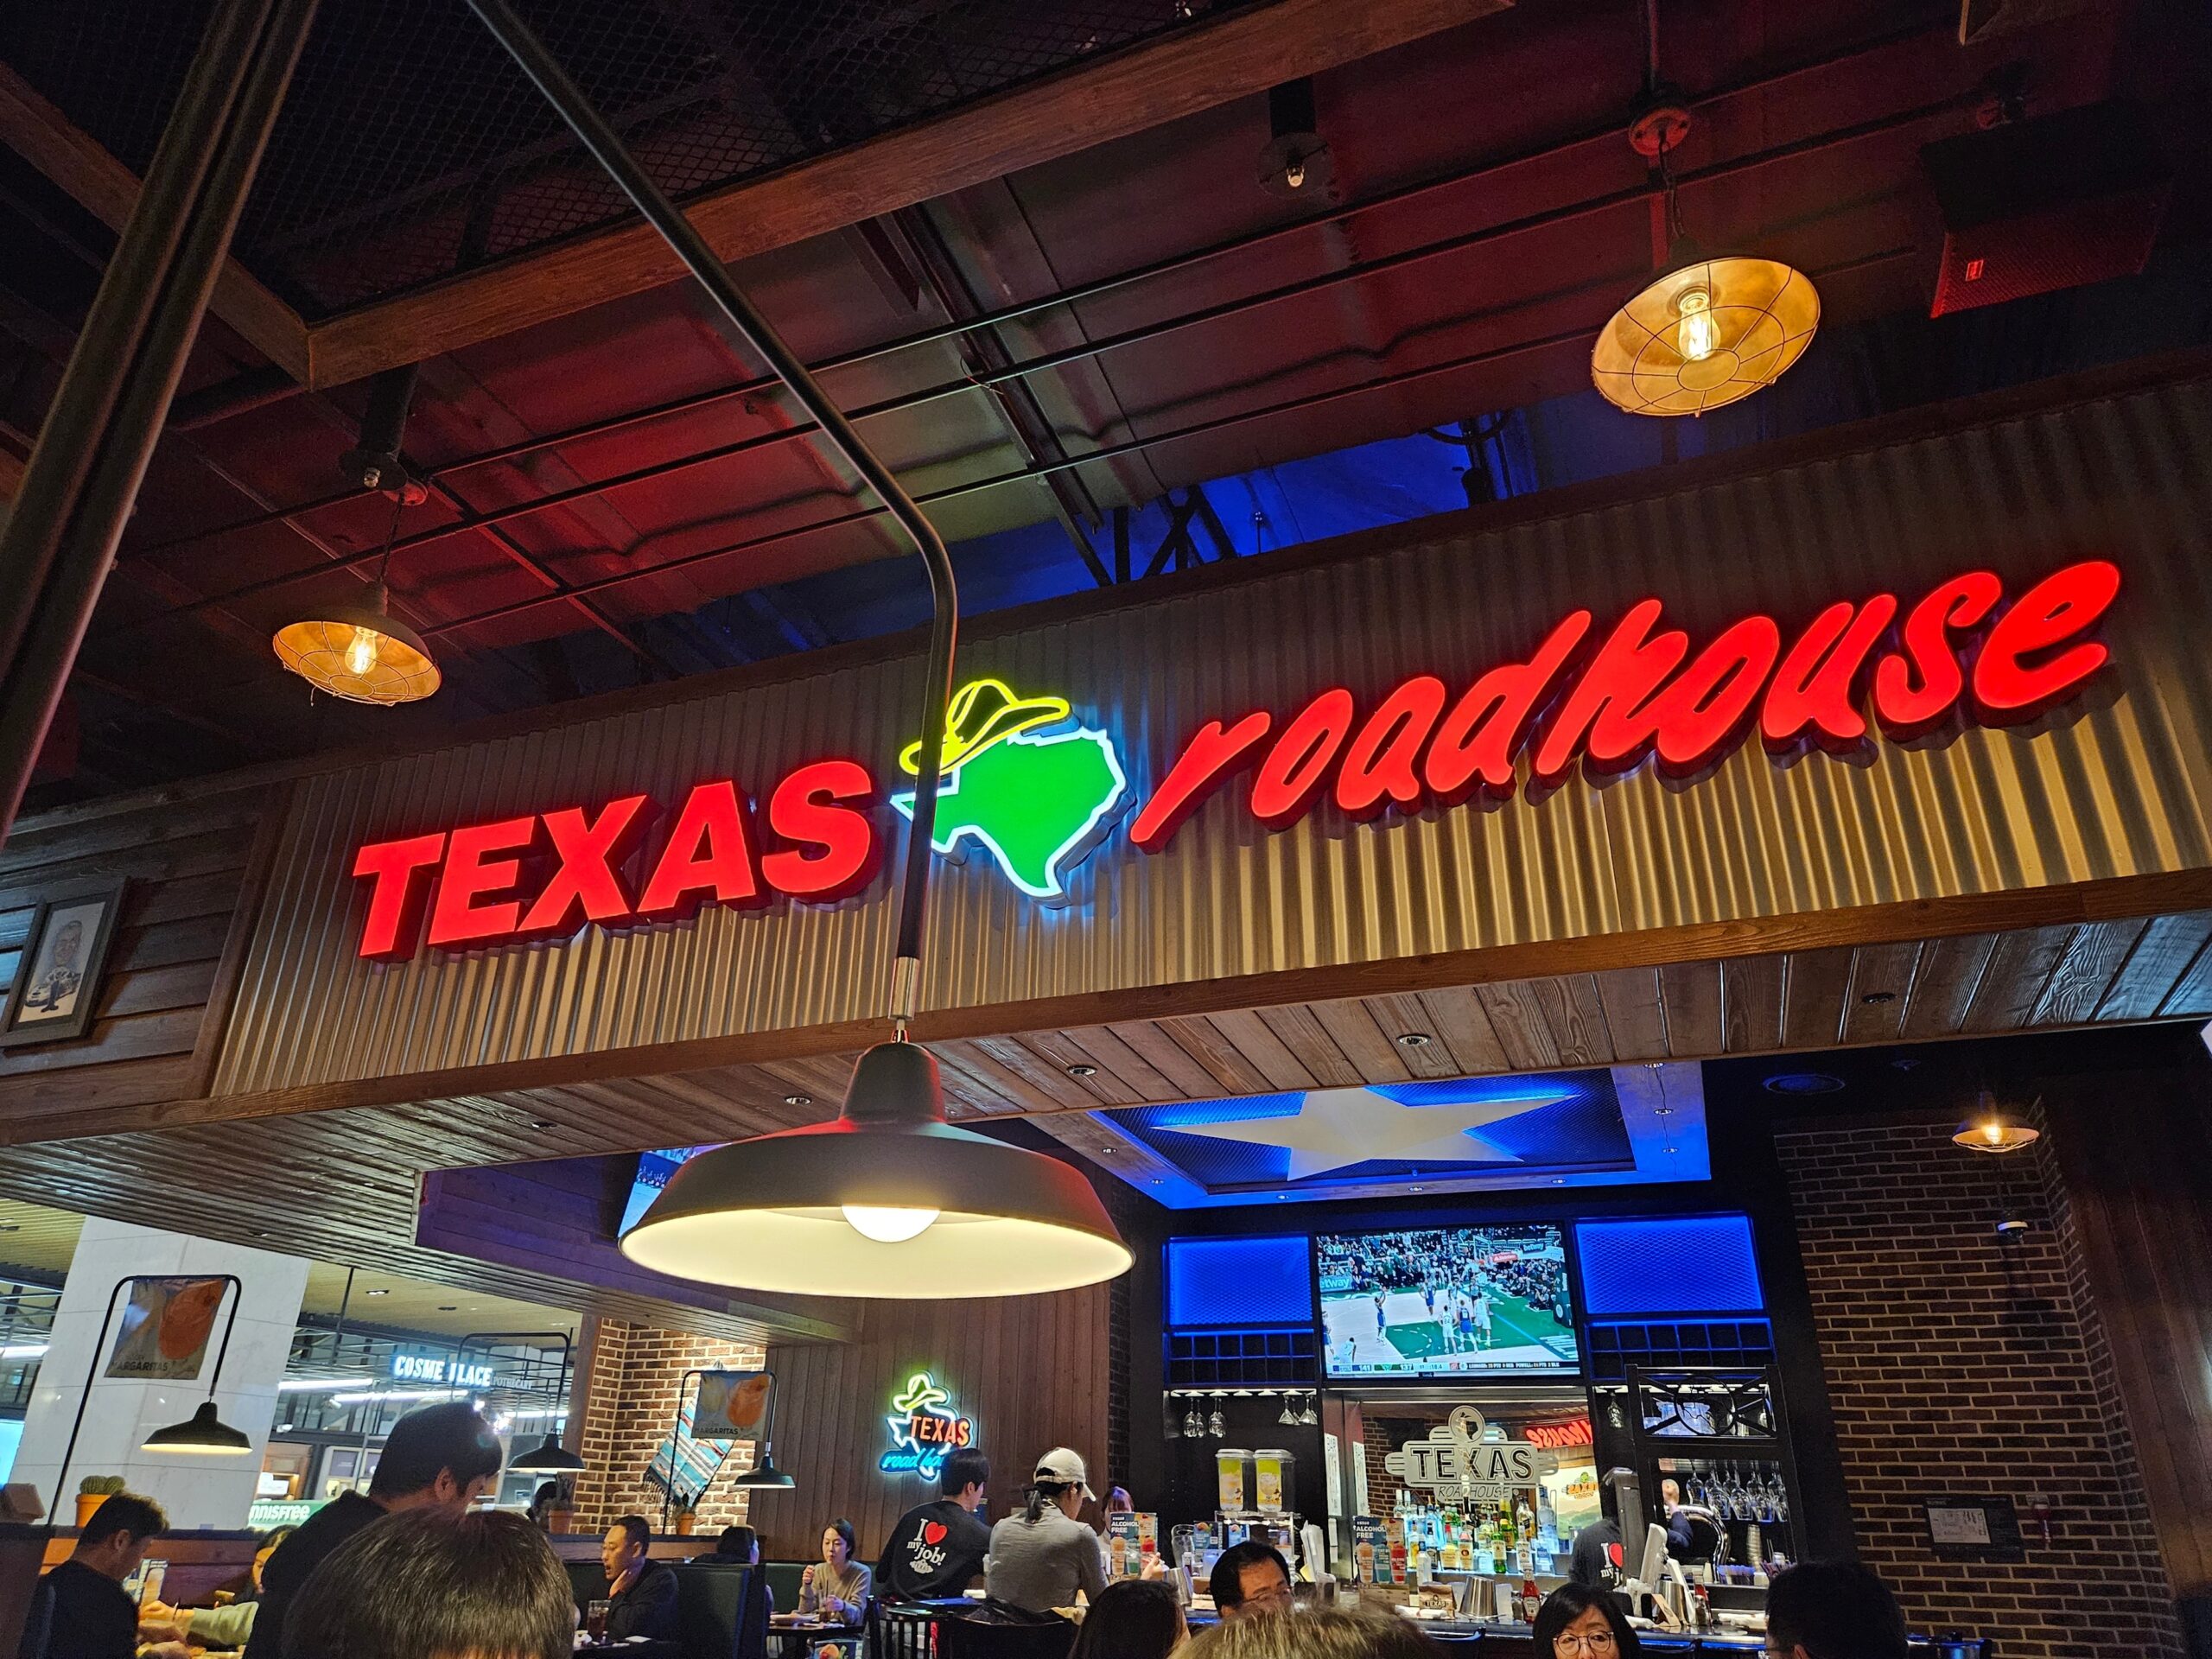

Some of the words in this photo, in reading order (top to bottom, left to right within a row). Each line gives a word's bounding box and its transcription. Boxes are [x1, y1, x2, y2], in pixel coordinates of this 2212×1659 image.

[353, 760, 874, 957] TEXAS
[1131, 560, 2121, 847] roadhouse
[394, 1355, 445, 1382] COSME
[910, 1415, 969, 1447] TEXAS
[1410, 1446, 1534, 1481] TEXAS
[1439, 1485, 1510, 1498] ROAHOUSE
[913, 1517, 929, 1541] I
[906, 1541, 922, 1553] my
[913, 1543, 947, 1567] job!
[1600, 1542, 1613, 1568] I
[1600, 1567, 1614, 1580] my
